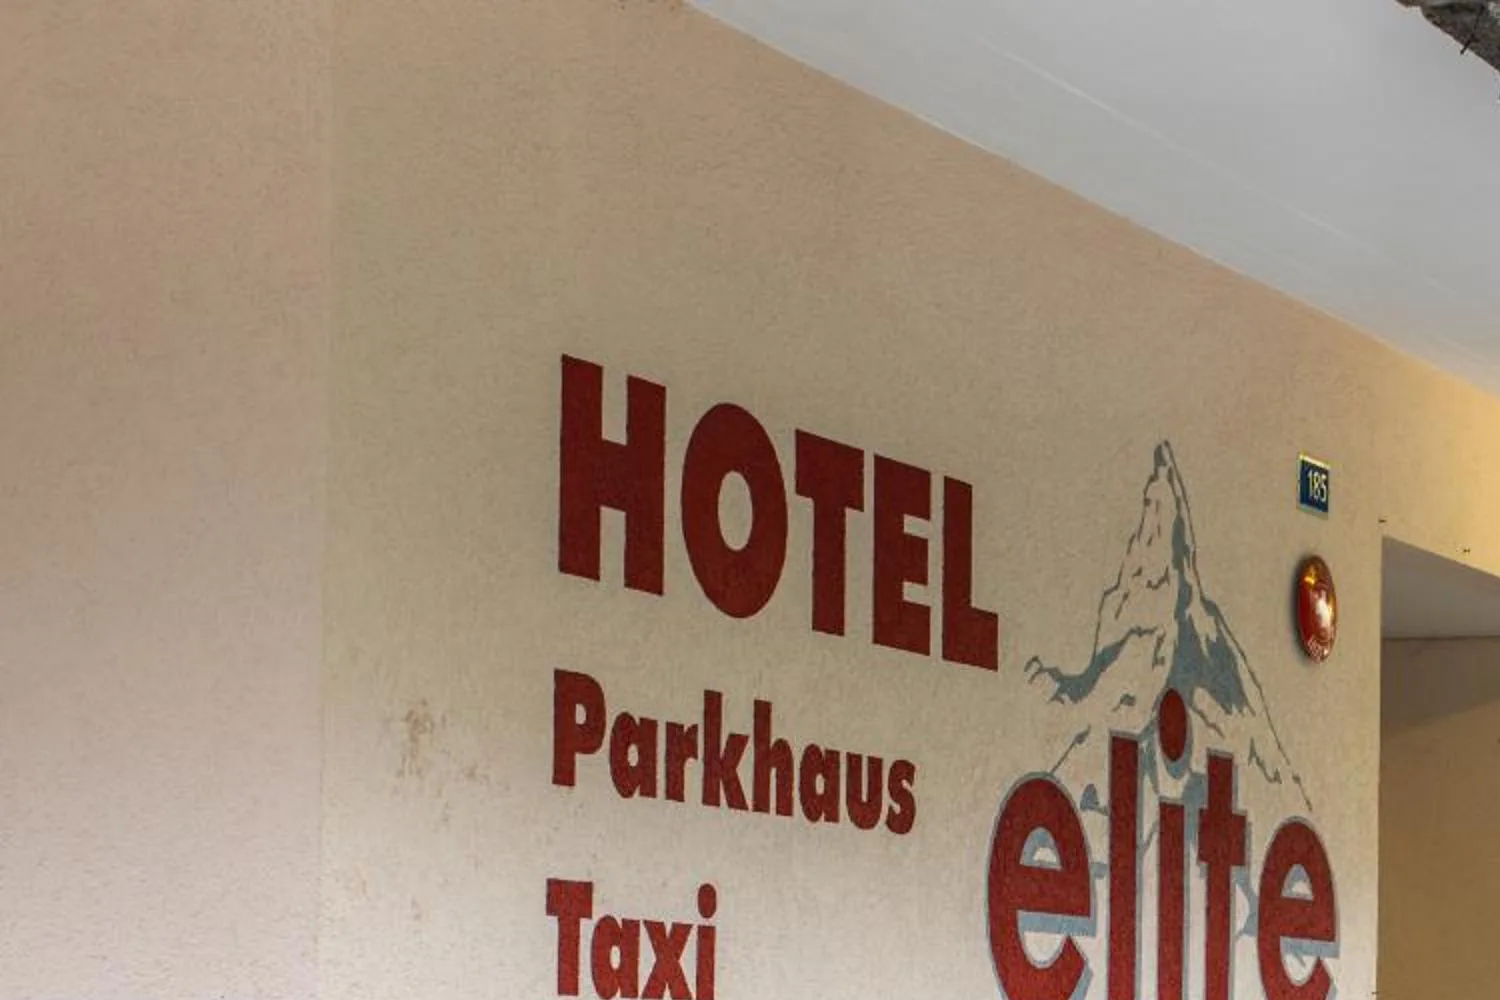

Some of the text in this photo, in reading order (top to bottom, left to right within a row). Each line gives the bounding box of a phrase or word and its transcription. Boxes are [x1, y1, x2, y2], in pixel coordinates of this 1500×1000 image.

[559, 352, 998, 671] HOTEL
[1307, 469, 1328, 502] 185
[552, 669, 916, 834] Parkhaus
